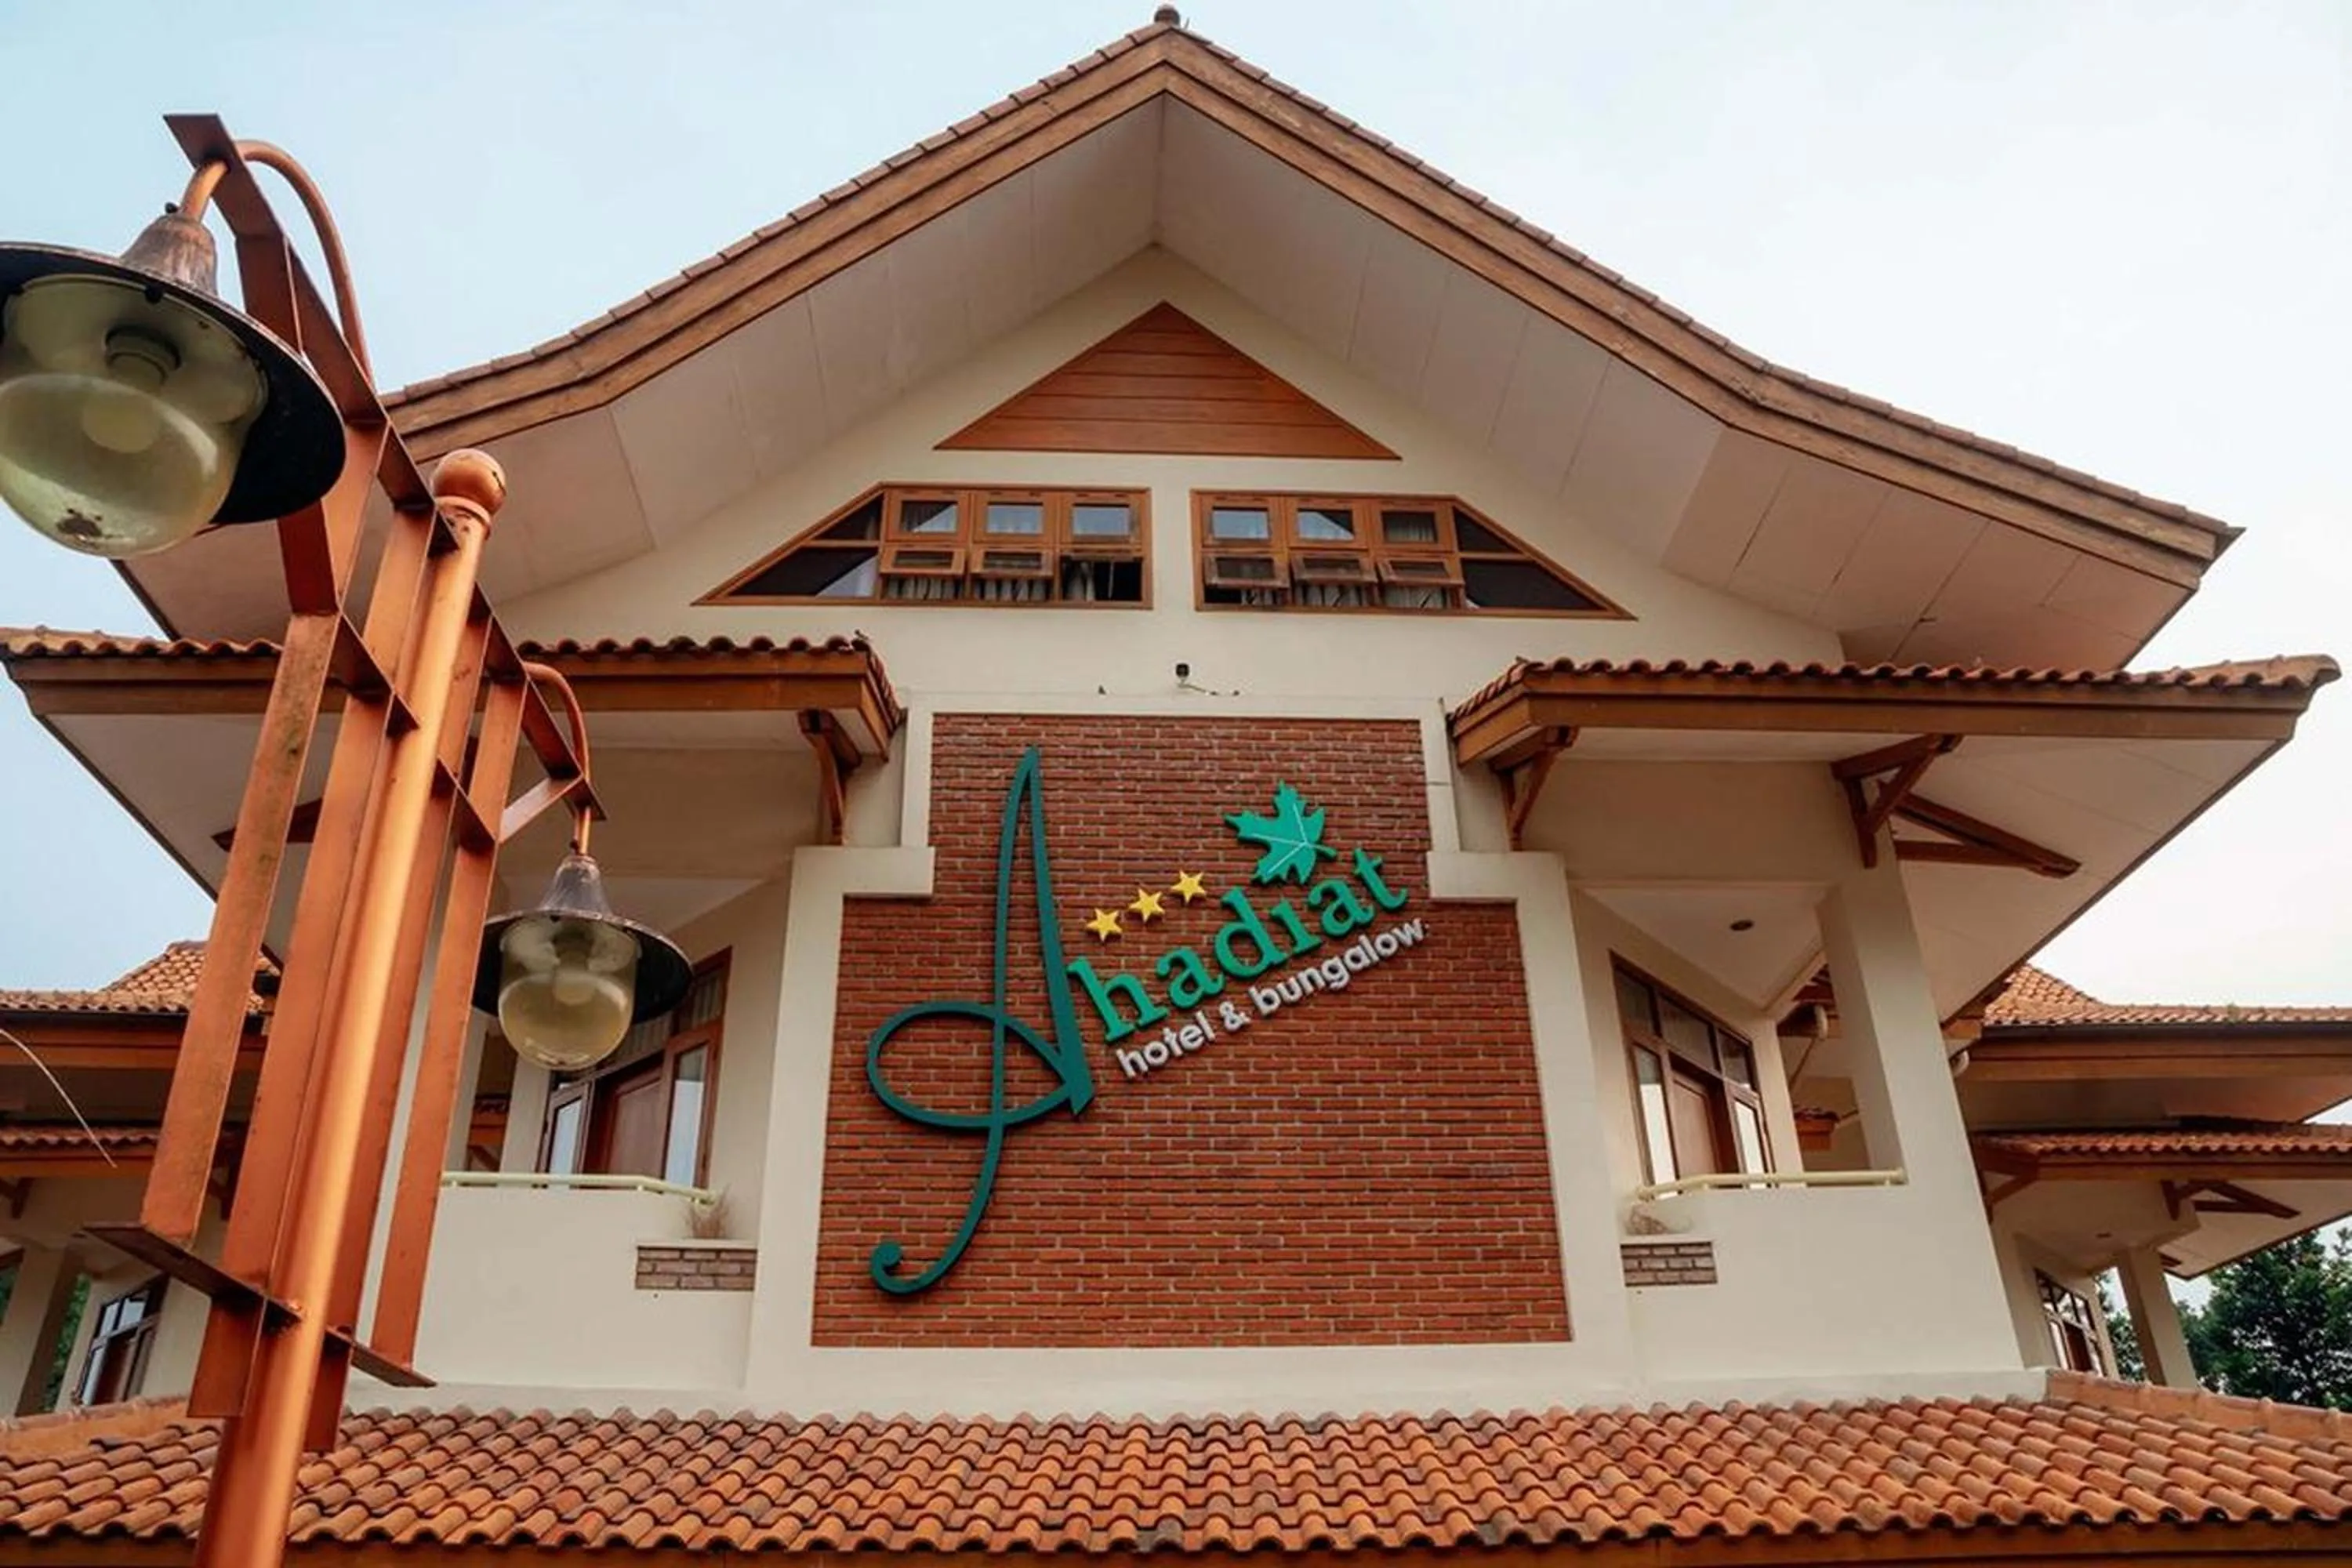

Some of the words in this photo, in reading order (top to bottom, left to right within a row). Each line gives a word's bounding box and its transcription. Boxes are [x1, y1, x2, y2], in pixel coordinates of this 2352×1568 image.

[866, 745, 1408, 1295] Ahadiat
[1115, 1011, 1217, 1078] hotel
[1218, 1000, 1251, 1032] &
[1249, 917, 1426, 1017] bungalow
